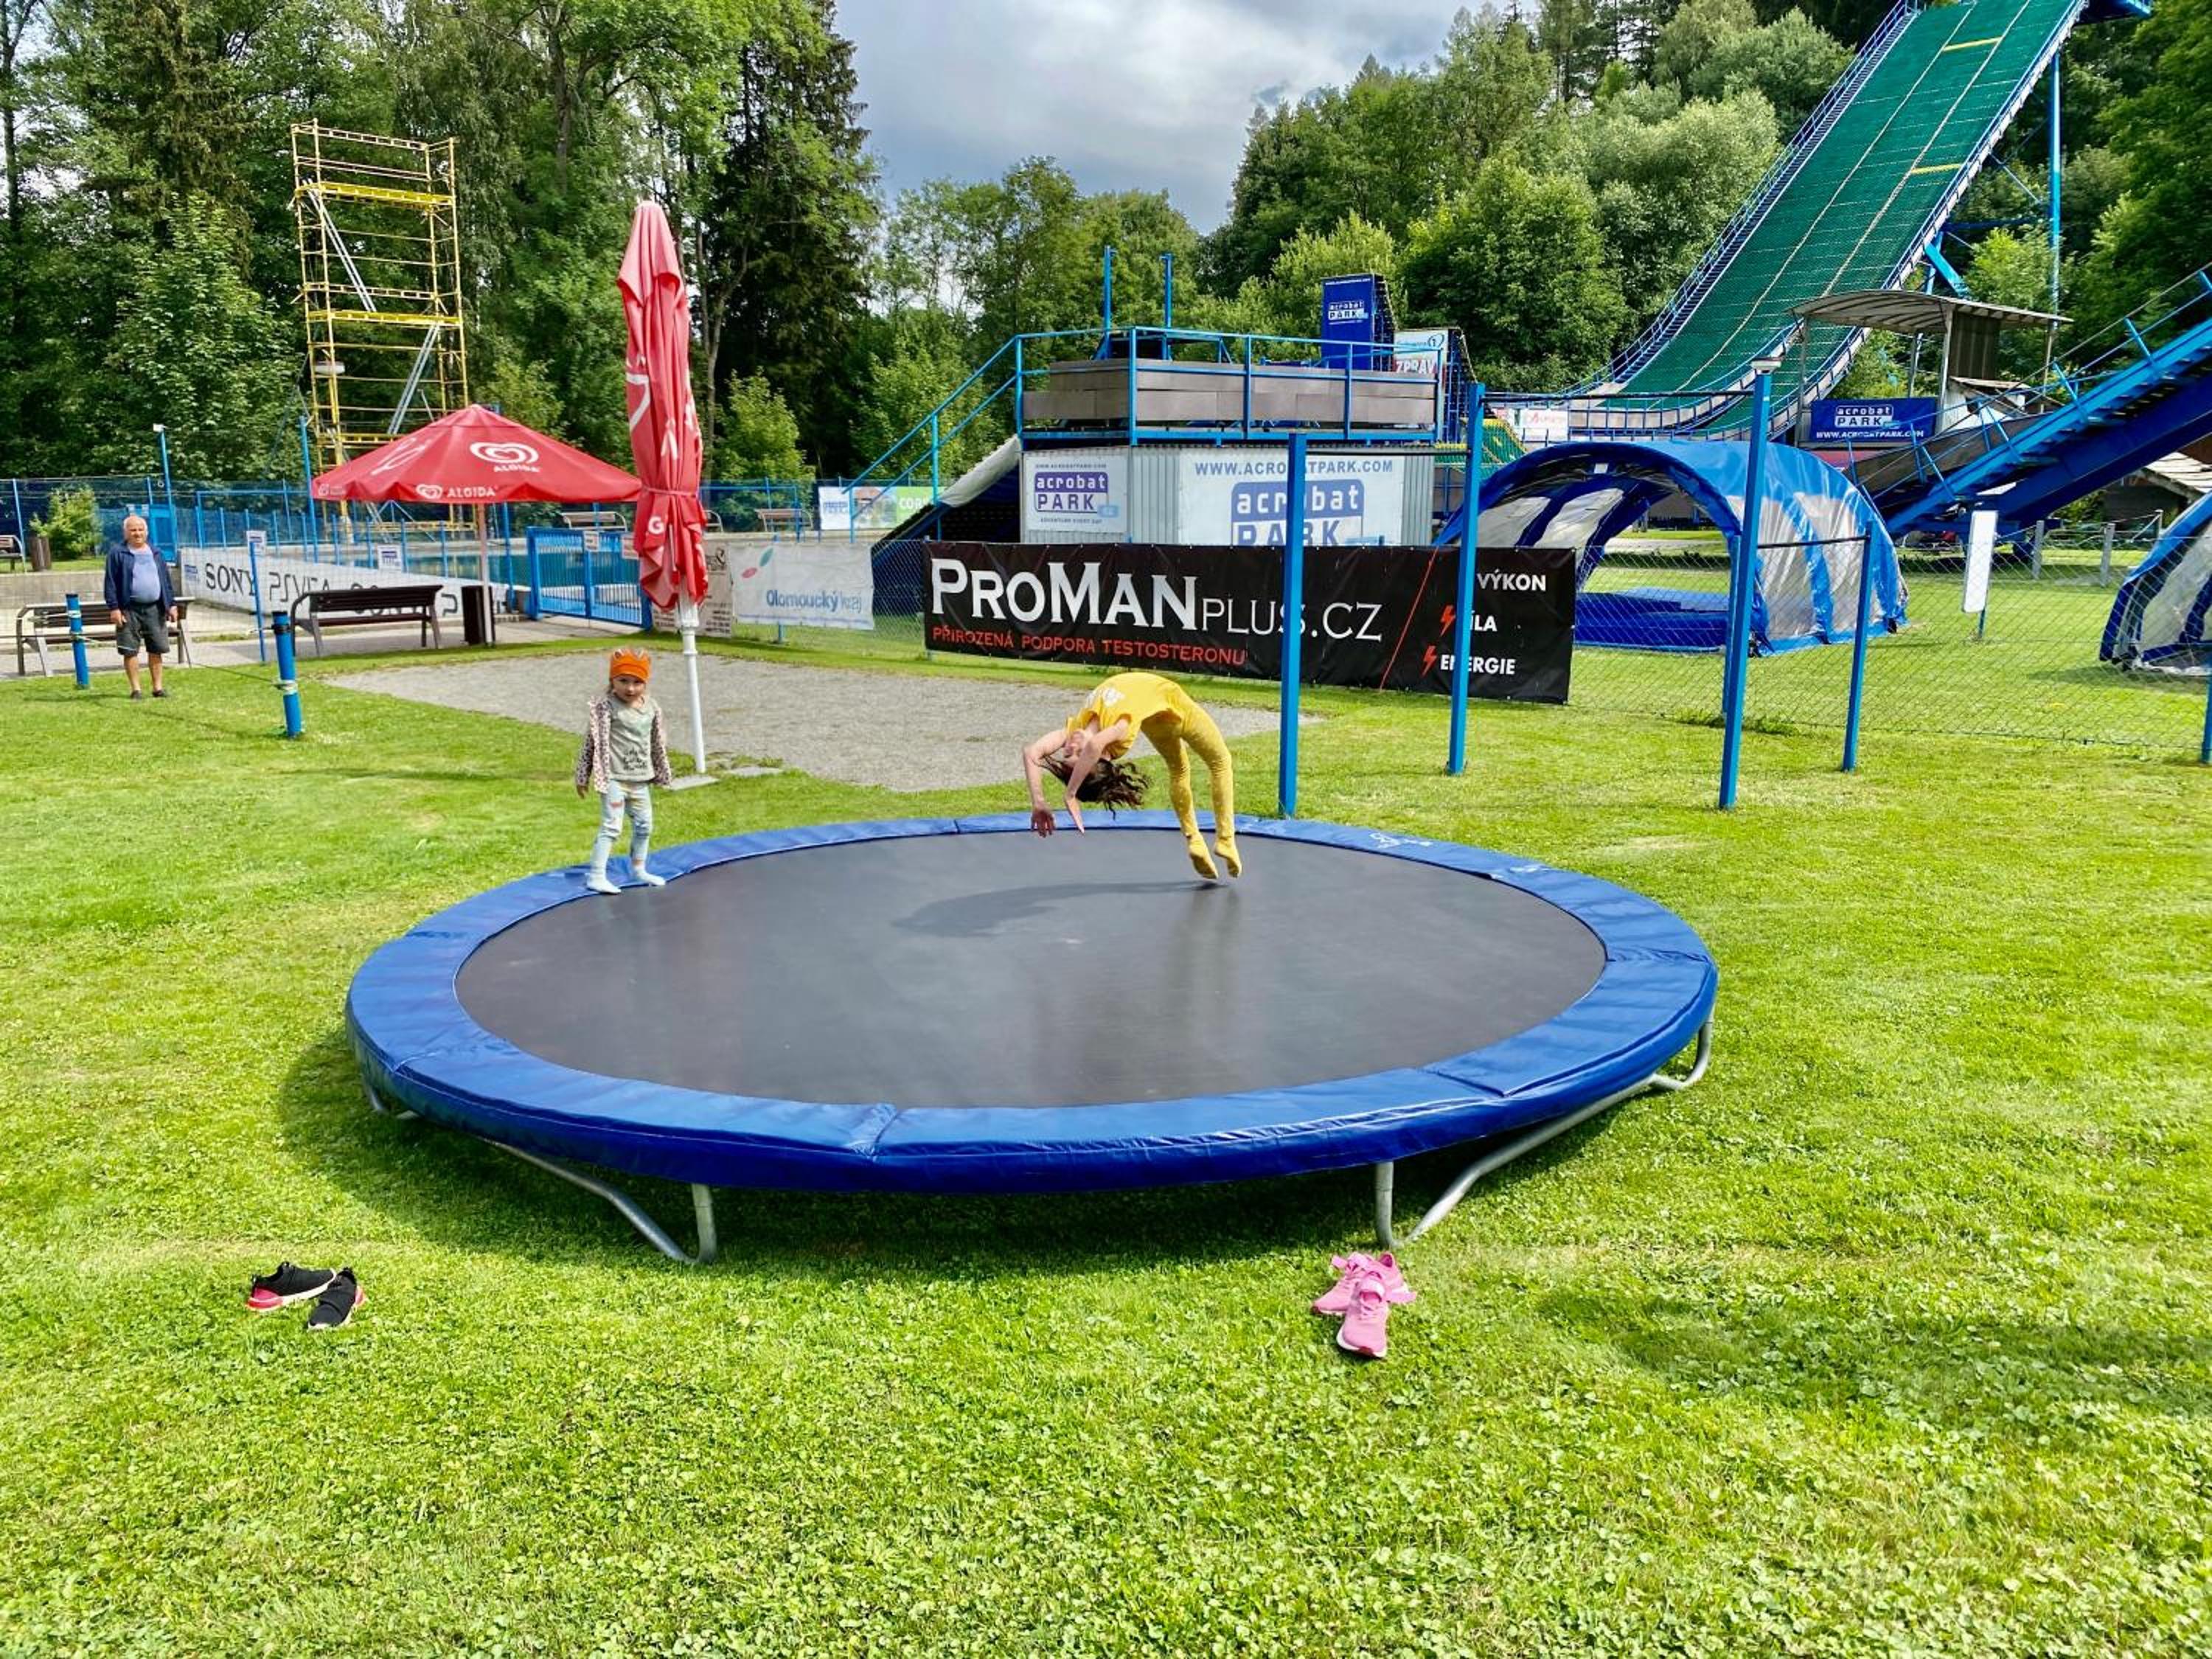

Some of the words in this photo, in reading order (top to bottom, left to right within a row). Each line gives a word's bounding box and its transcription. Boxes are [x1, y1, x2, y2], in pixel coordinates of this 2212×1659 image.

[1837, 407, 1889, 415] acrobat
[1837, 417, 1882, 425] PARK
[1195, 460, 1393, 476] WWW.ACROTPARK.COM
[1037, 475, 1105, 488] acrobat
[447, 486, 496, 498] ALGIDA
[1037, 493, 1094, 510] PARK
[1237, 485, 1359, 515] acrbat
[205, 563, 257, 597] SONY
[1477, 568, 1546, 591] VÝKON
[766, 589, 838, 613] Olomoucký
[1470, 610, 1498, 632] ÍLA
[932, 624, 1014, 648] PŘIROZENÁ
[1021, 636, 1096, 654] PODPORA
[1102, 639, 1247, 665] TESTOSTERONU
